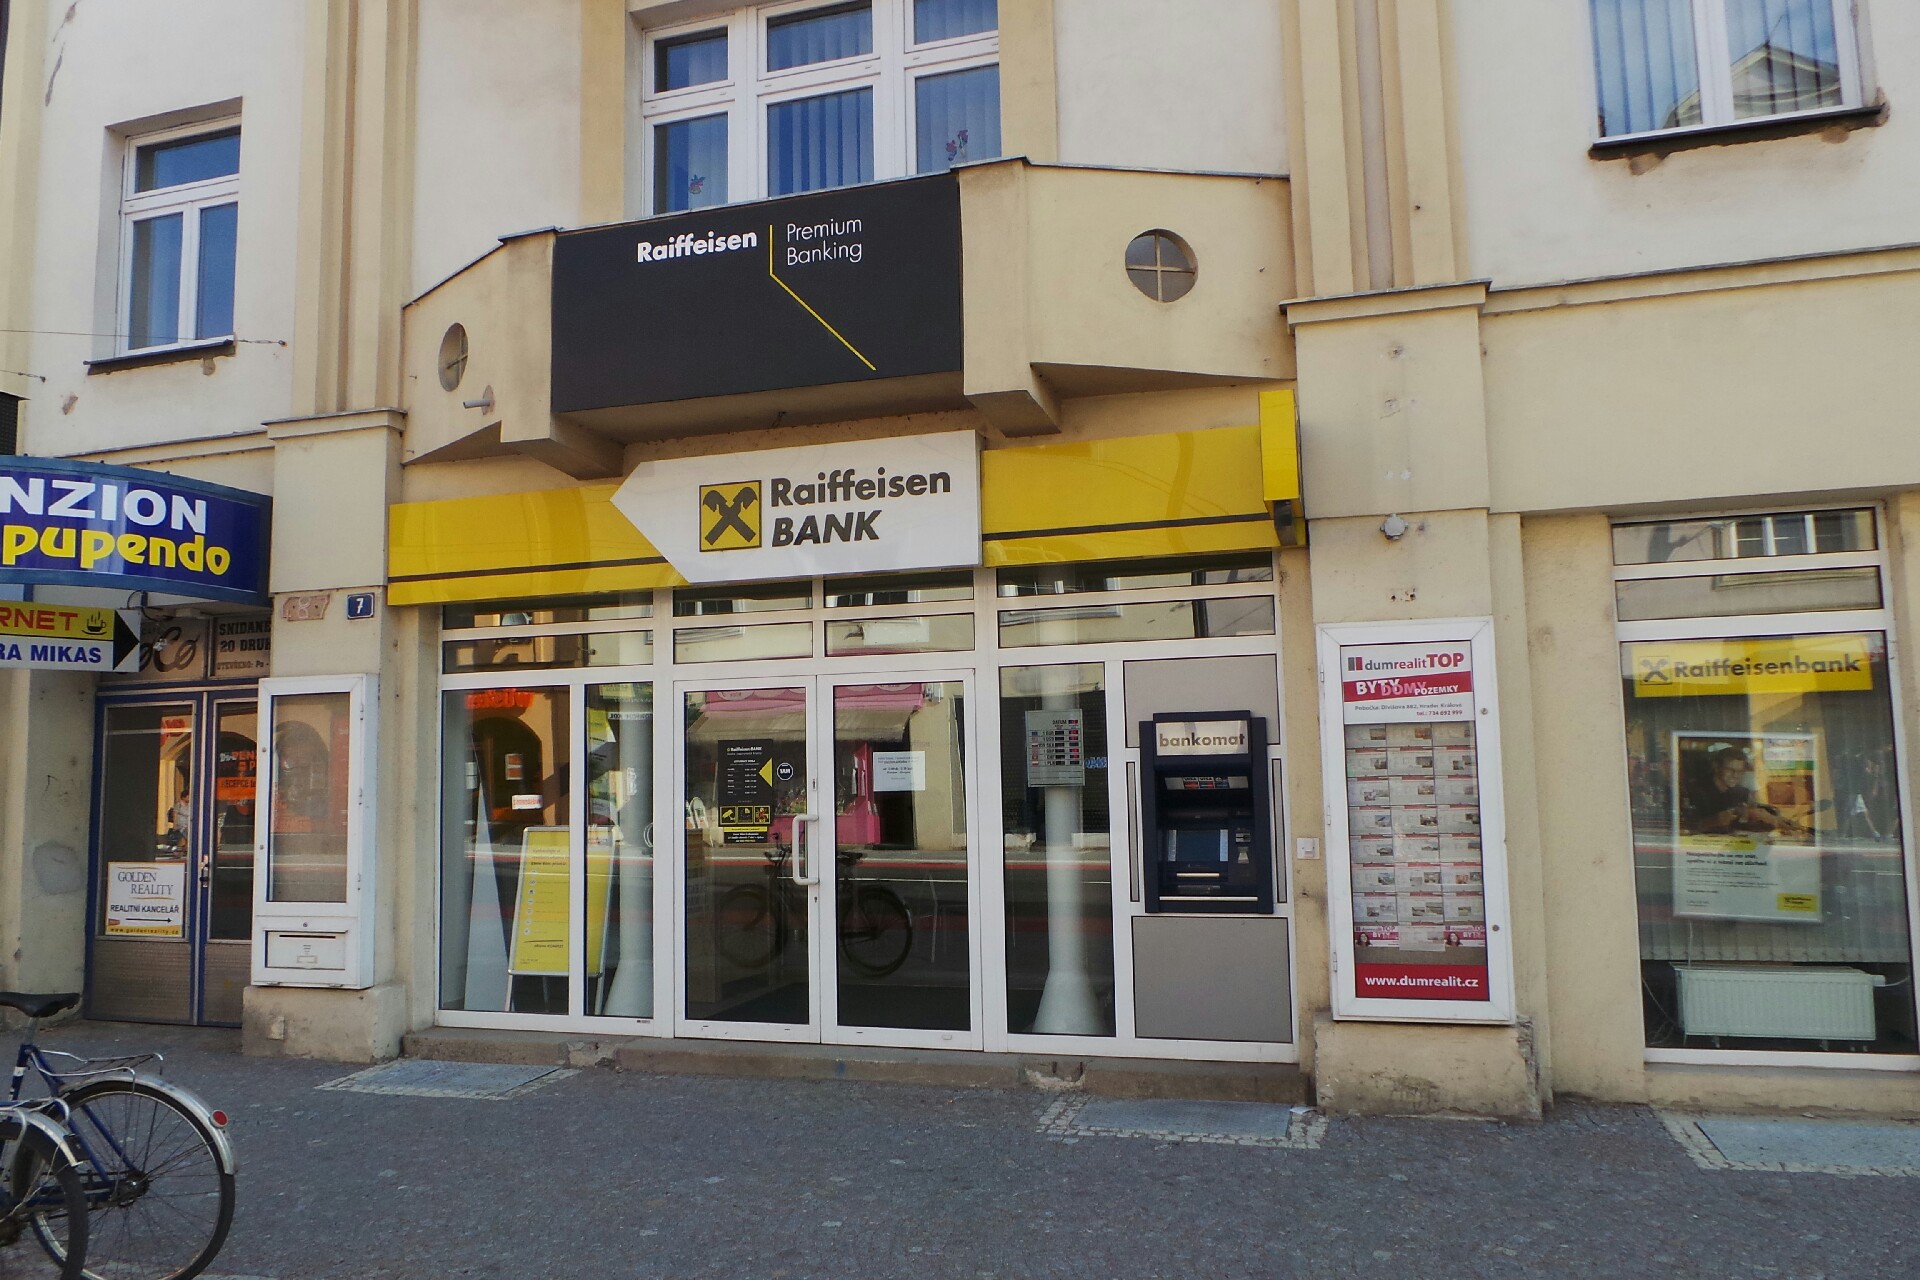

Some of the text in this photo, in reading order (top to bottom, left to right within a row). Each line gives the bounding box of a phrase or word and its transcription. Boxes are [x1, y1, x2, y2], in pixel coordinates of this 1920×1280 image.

[786, 217, 863, 243] Premium
[636, 230, 758, 264] Raiffeisen
[786, 240, 863, 267] Banking
[770, 466, 951, 508] Raiffeisen
[771, 509, 882, 548] BANK
[2, 524, 231, 577] pupendo
[355, 597, 365, 614] 7
[30, 644, 102, 664] MIKAS
[1674, 653, 1861, 679] Raiffeisenbank
[1356, 678, 1459, 697] BYTY DOMY POZEMKY
[1158, 732, 1246, 749] bankomat
[117, 871, 157, 883] GOLDEN
[130, 883, 174, 895] REALITY
[141, 904, 180, 914] KANCELÁŘ
[1364, 975, 1479, 988] www.dumrealit.cz
